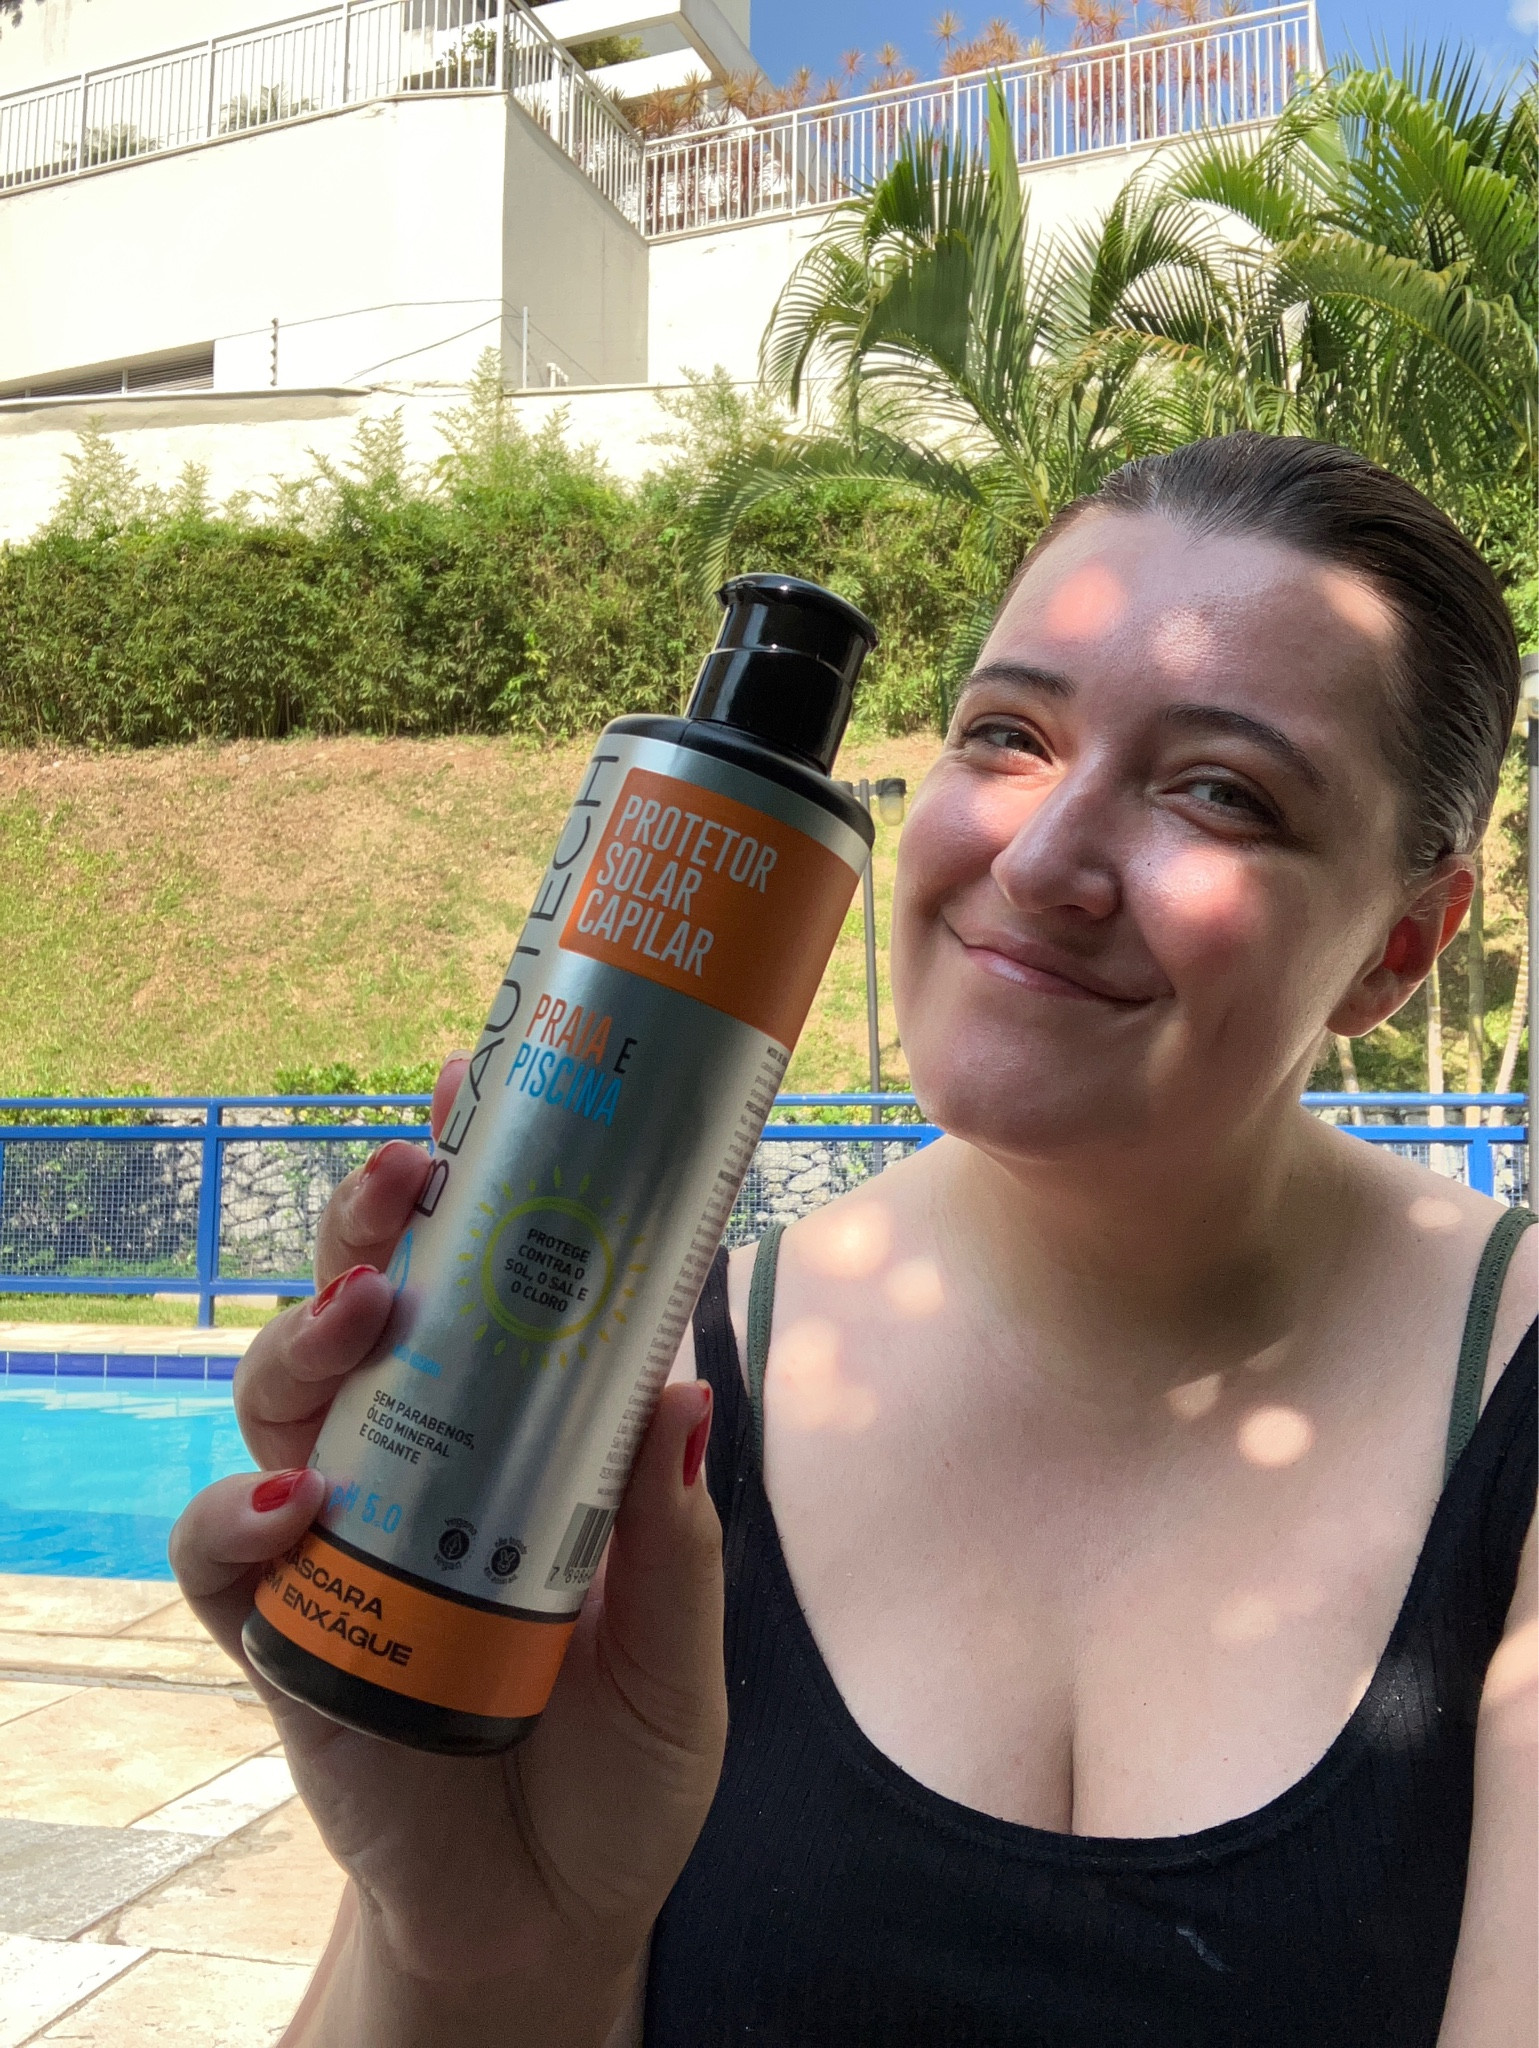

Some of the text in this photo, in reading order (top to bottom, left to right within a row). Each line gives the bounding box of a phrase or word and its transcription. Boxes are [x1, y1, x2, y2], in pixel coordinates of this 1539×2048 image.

[615, 794, 778, 893] PROTETOR
[596, 841, 703, 916] SOLAR
[577, 888, 715, 977] CAPILAR
[525, 993, 638, 1074] PRAIA E
[505, 1042, 622, 1127] PISCINA
[518, 1244, 585, 1280] CONTRA O
[527, 1228, 591, 1263] PROTEGE
[505, 1258, 589, 1301] SOL, O SAL E
[510, 1280, 569, 1313] O CLORO
[359, 1422, 422, 1465] E CORANTE
[366, 1404, 450, 1458] ÓLEO MINERAL
[373, 1389, 475, 1451] SEM PARABENOS,
[326, 1481, 403, 1535] pH 5.0
[282, 1583, 413, 1667] ENXÁGUE
